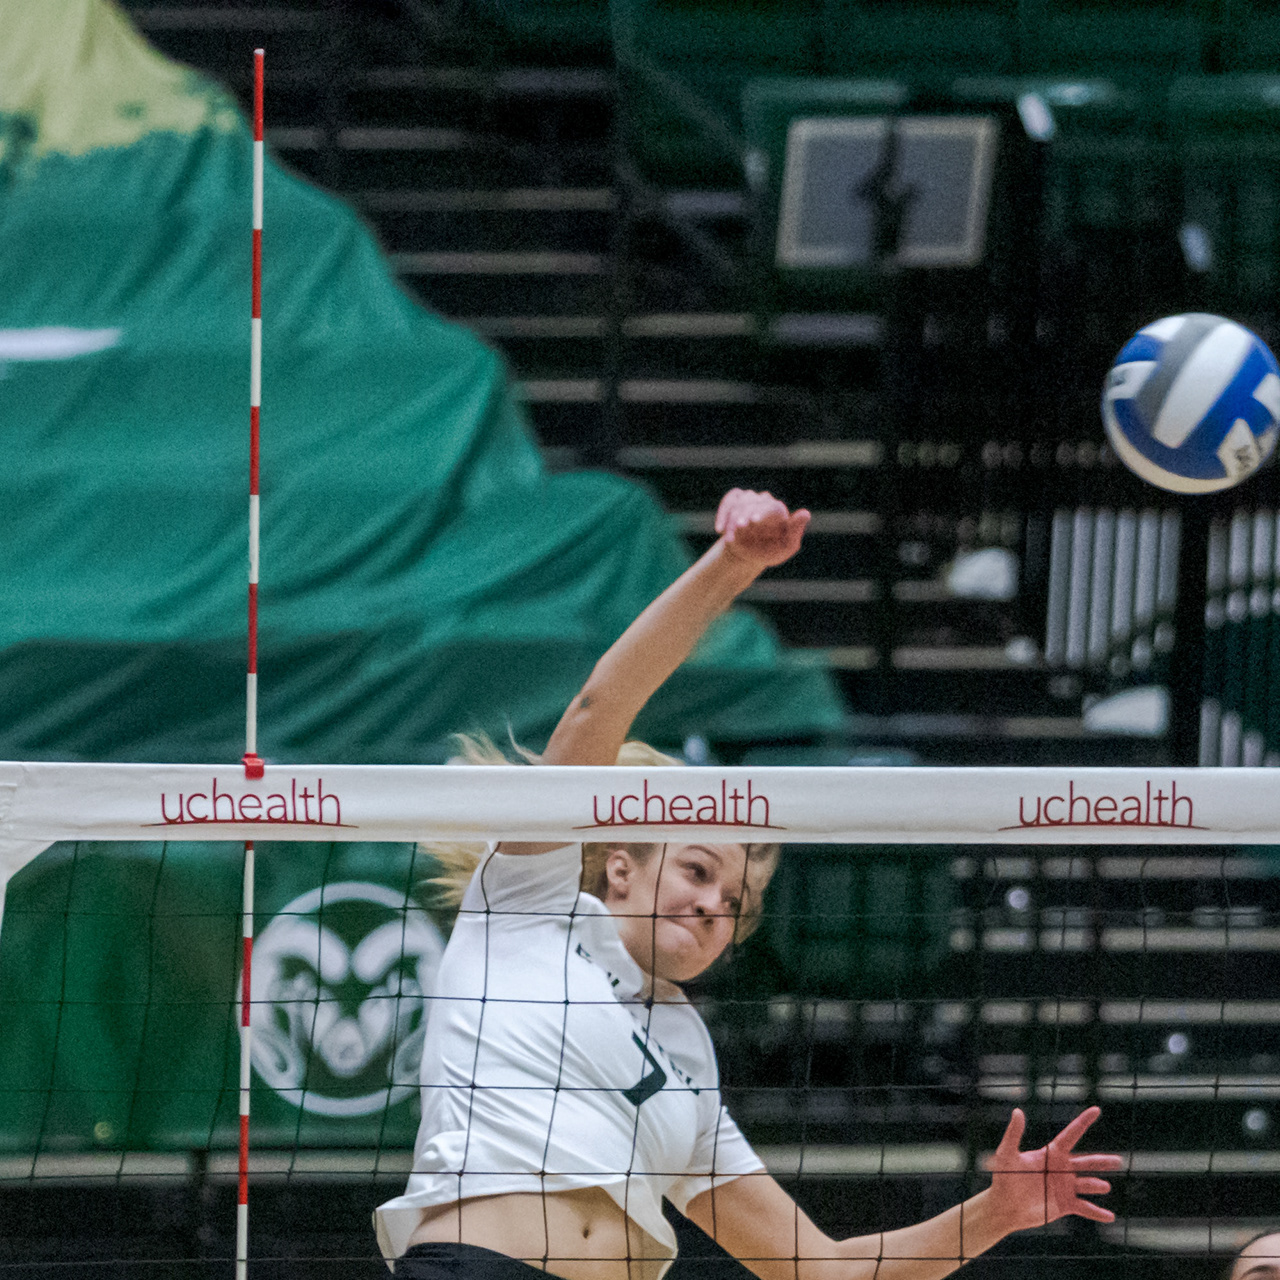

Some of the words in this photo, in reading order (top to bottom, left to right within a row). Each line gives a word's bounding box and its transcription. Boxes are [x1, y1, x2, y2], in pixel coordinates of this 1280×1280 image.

[159, 778, 342, 825] uchealth
[592, 778, 771, 825] uchealth
[1018, 779, 1194, 826] uchealth
